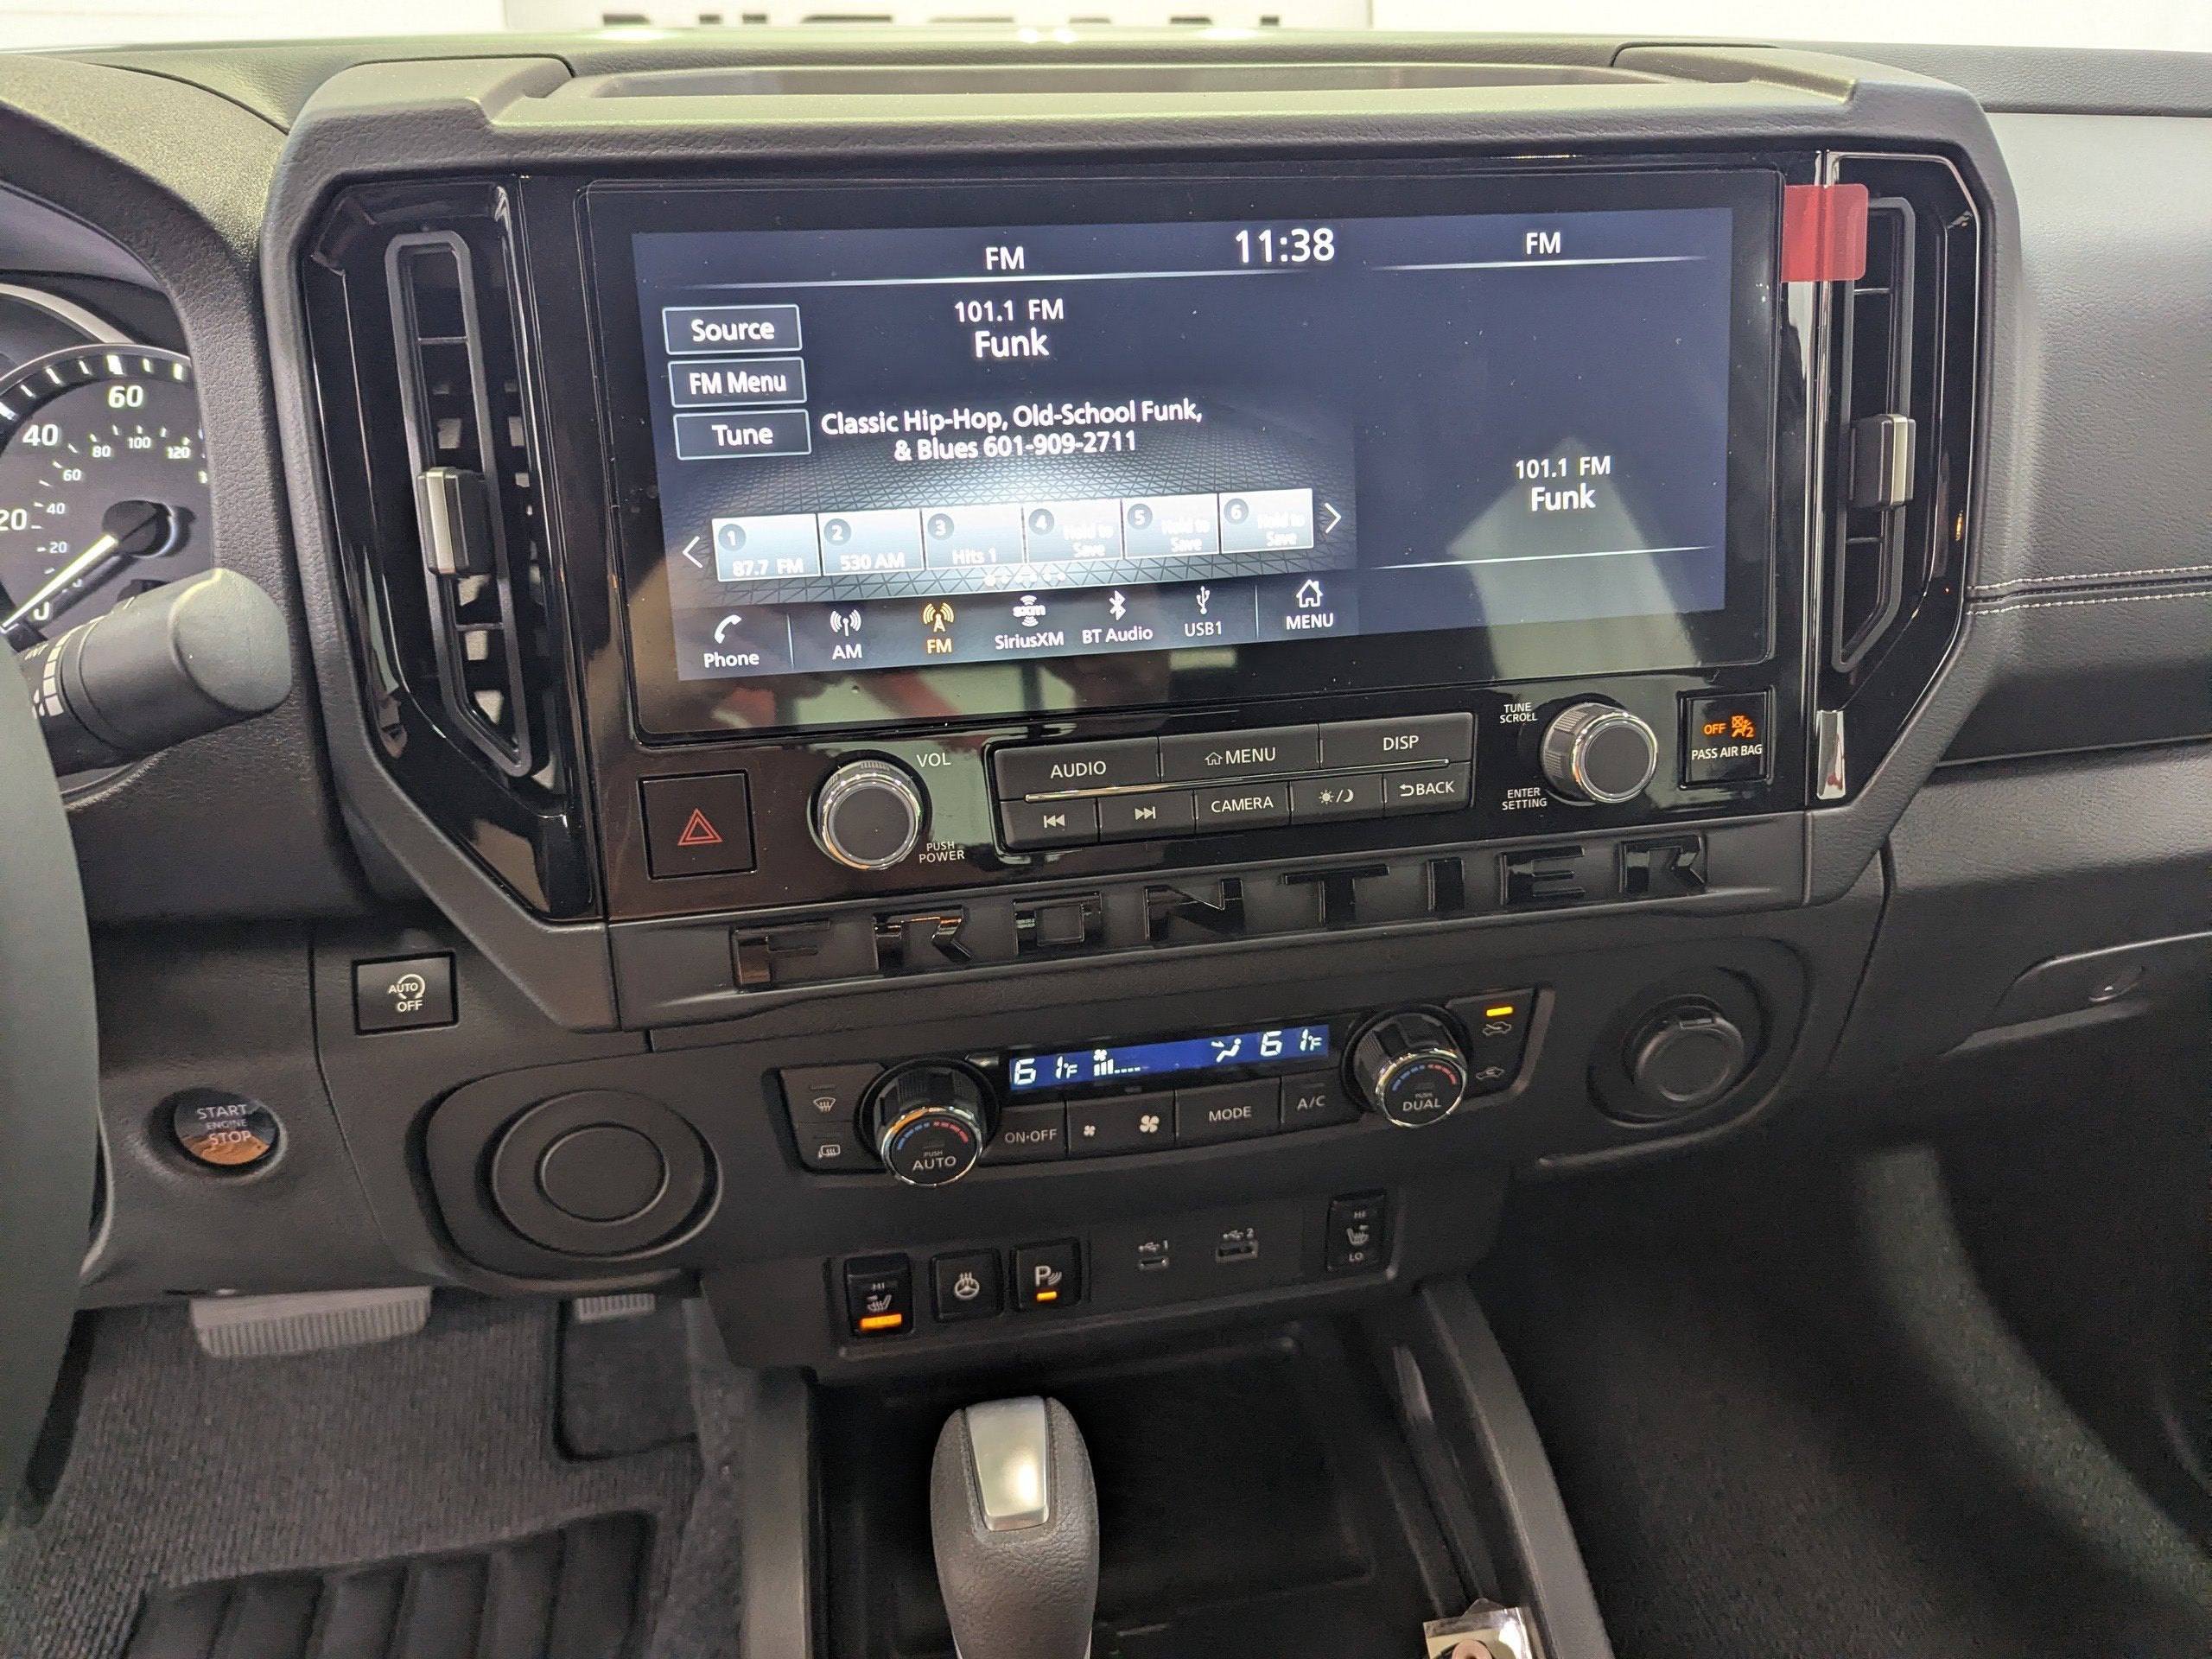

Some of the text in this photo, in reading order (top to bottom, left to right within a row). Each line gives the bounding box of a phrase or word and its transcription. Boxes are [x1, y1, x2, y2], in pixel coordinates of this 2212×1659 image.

[1235, 228, 1335, 263] 11:38
[1526, 232, 1561, 254] FM
[985, 247, 1025, 270] FM
[954, 299, 1065, 323] 101.1 FM
[691, 319, 775, 342] Source
[975, 328, 1050, 358] Funk
[690, 371, 787, 395] FM Menu
[108, 385, 143, 409] 60
[821, 397, 1203, 435] Classic Hip-Hop, Old-School Funk,
[22, 423, 59, 447] 40
[128, 436, 151, 448] 100
[712, 423, 773, 446] Tune
[92, 446, 111, 458] 80
[166, 447, 191, 459] 120
[894, 431, 1137, 461] & Blues 601-909-2711
[62, 469, 82, 481] 60
[1516, 454, 1611, 479] 101.1 FM
[1530, 485, 1596, 512] Funk
[47, 502, 66, 515] 40
[1230, 505, 1243, 520] 6
[1135, 510, 1146, 525] 5
[831, 525, 844, 541] 2
[936, 520, 947, 536] 3
[727, 530, 736, 547] 1
[49, 541, 67, 554] 20
[952, 547, 997, 565] Hits 1
[733, 557, 804, 577] 87.7 FM
[840, 552, 906, 571] 530 AM
[1184, 620, 1223, 638] USB1
[1286, 613, 1334, 631] MENU
[995, 630, 1065, 650] SiriusXM
[1082, 625, 1154, 645] BT Audio
[832, 644, 862, 660] AM
[926, 638, 952, 654] FM
[703, 652, 760, 668] Phone
[1503, 702, 1532, 714] TUNE
[1499, 710, 1538, 724] SCROLL
[1703, 722, 1726, 735] OFF
[1382, 734, 1420, 752] DISP
[917, 752, 952, 768] VOL
[1225, 747, 1276, 765] MENU
[1691, 744, 1763, 760] PASS AIR BAG
[1050, 760, 1107, 779] AUDIO
[1415, 780, 1455, 798] BACK
[1506, 786, 1541, 801] ENTER
[1211, 796, 1274, 813] CAMERA
[1501, 797, 1548, 810] SETTING
[925, 841, 956, 853] PUSH
[918, 849, 966, 863] POWER
[389, 982, 419, 995] AUTO
[396, 1000, 423, 1013] OFF
[1296, 1094, 1326, 1111] A/C
[1402, 1098, 1442, 1113] DUAL
[196, 1103, 248, 1121] START
[1208, 1105, 1252, 1122] MODE
[206, 1117, 248, 1131] ENGINE
[207, 1130, 251, 1147] STOP
[924, 1149, 944, 1158] PUSH
[912, 1155, 957, 1172] AUTO
